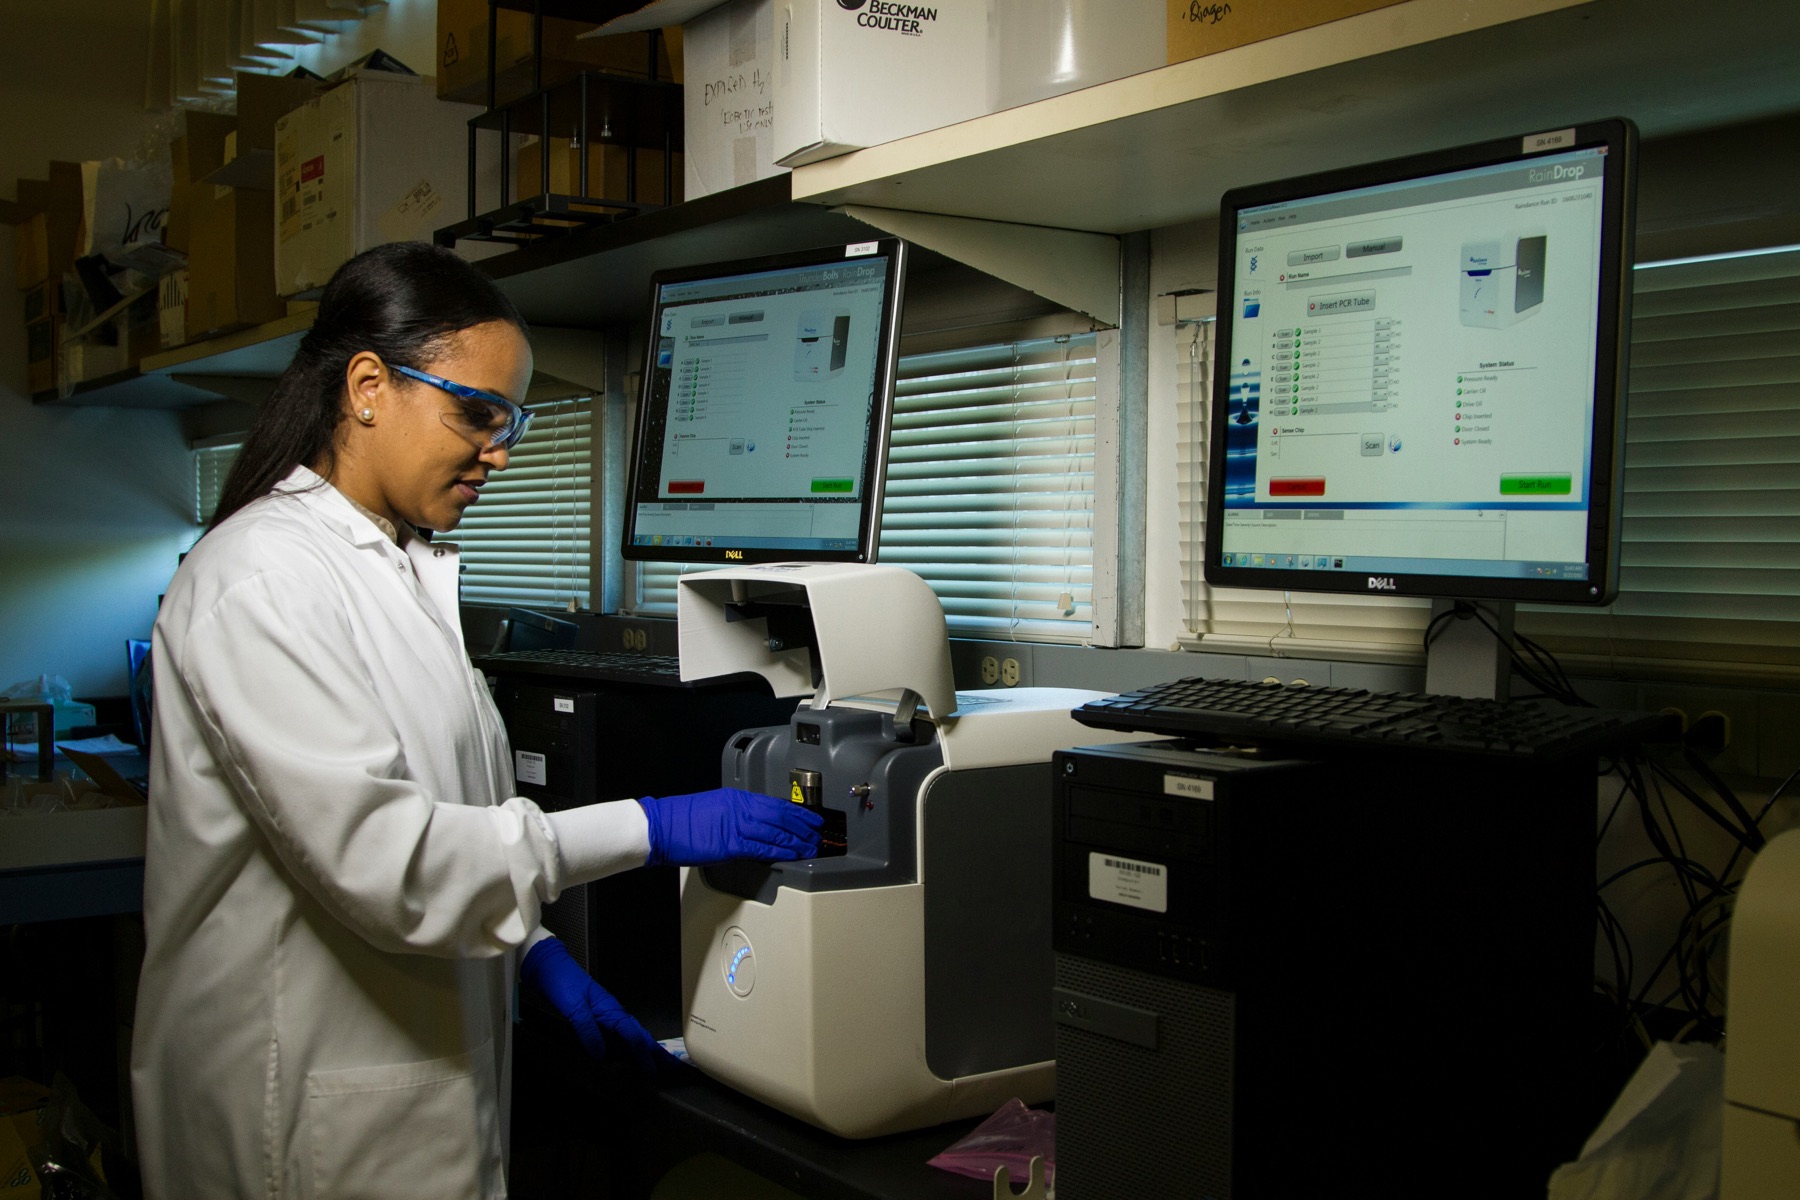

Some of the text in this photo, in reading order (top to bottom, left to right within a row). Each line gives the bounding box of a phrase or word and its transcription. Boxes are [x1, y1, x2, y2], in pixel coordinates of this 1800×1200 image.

[869, 0, 938, 21] BECKMAN
[857, 12, 920, 34] COULTER
[1529, 165, 1584, 183] RainDrop
[1362, 243, 1386, 252] Manual
[1303, 252, 1323, 262] Import
[1320, 298, 1370, 310] Insert PCR Tube
[725, 550, 743, 559] DELL
[1368, 577, 1396, 590] DELL
